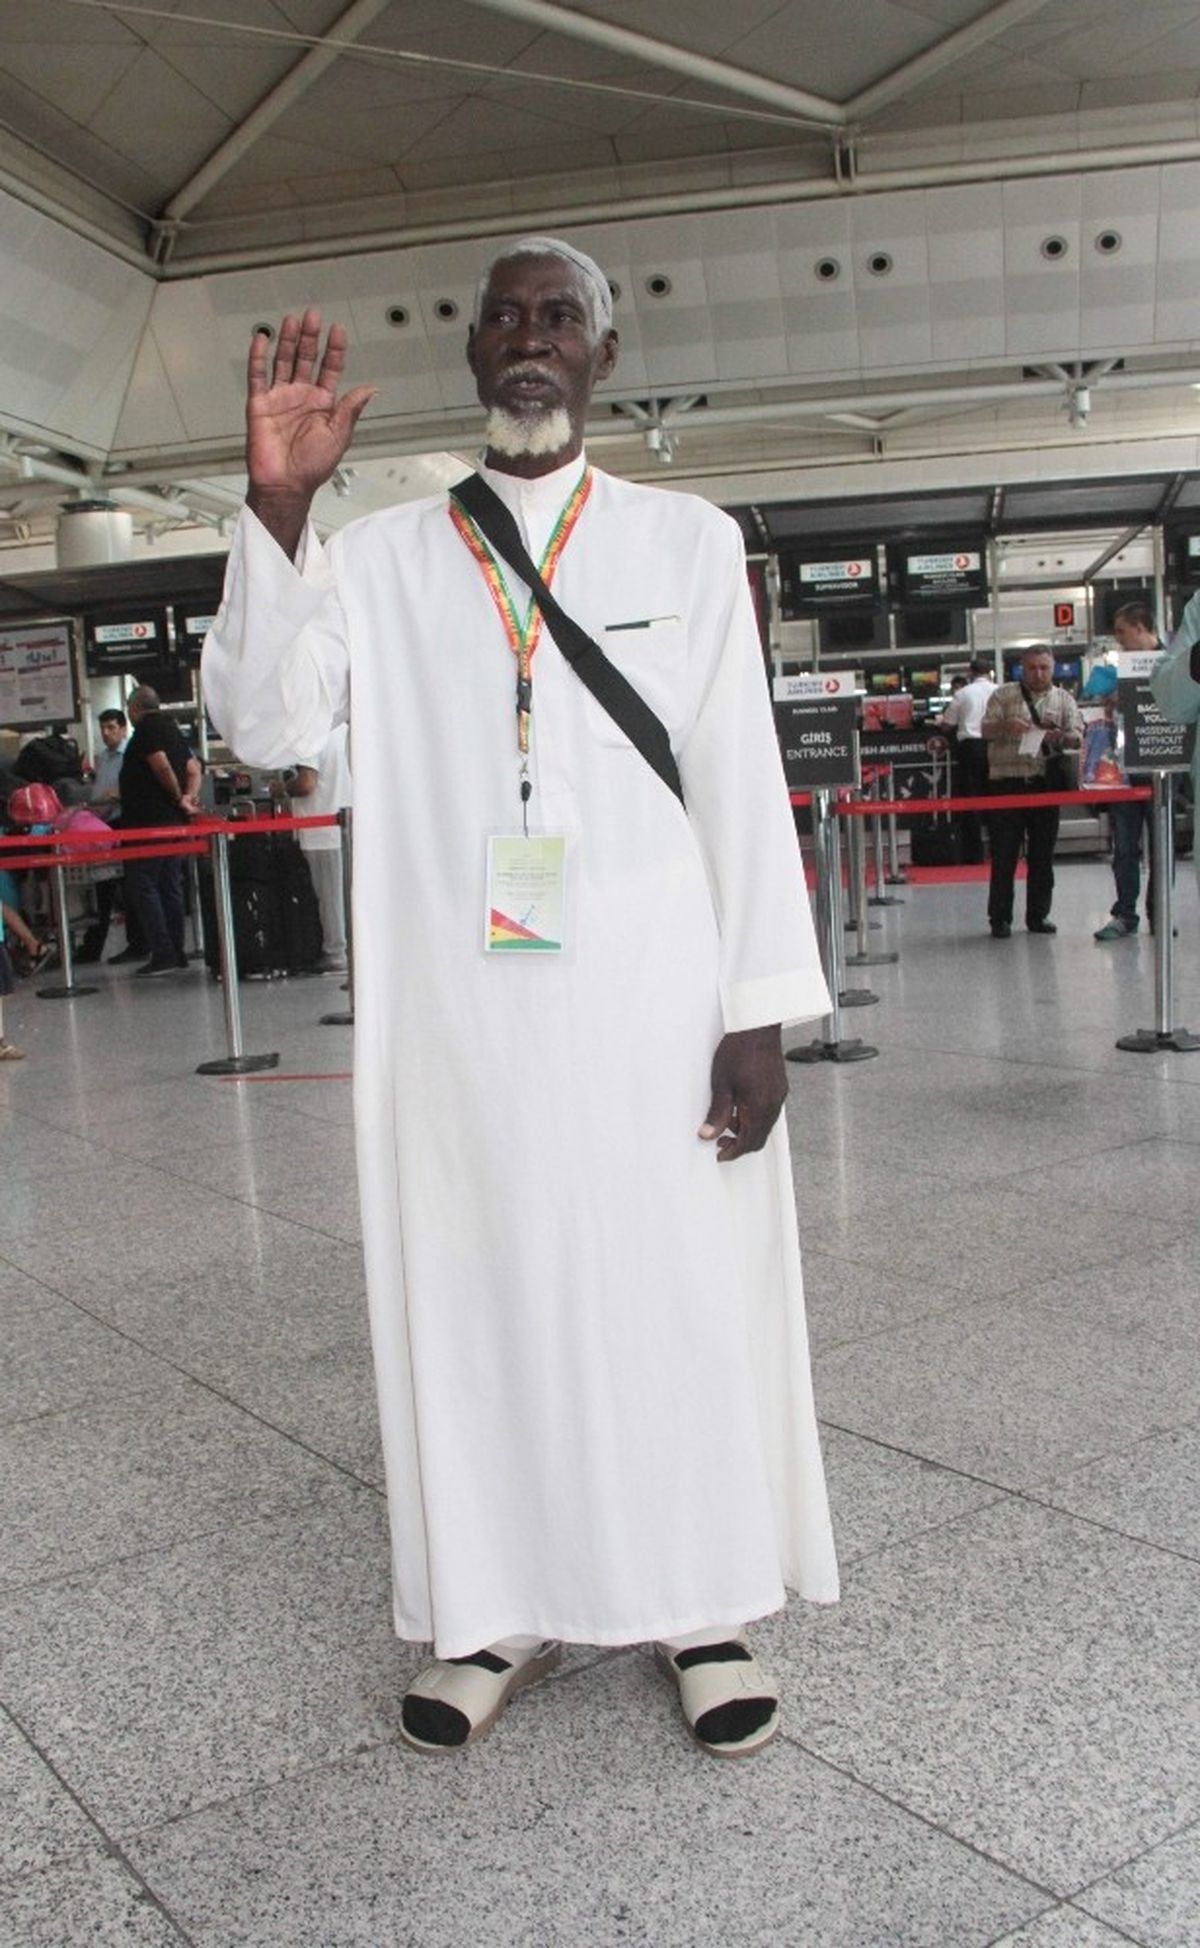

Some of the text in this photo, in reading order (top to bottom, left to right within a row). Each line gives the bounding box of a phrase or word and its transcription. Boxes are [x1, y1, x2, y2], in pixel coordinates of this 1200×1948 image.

[1058, 605, 1073, 625] D
[1135, 725, 1187, 736] PASSENGER
[1138, 735, 1183, 745] WITHOUT
[786, 746, 848, 761] ENTRANCE
[879, 743, 925, 754] AIRLINES
[1139, 745, 1183, 757] BAGGAGE
